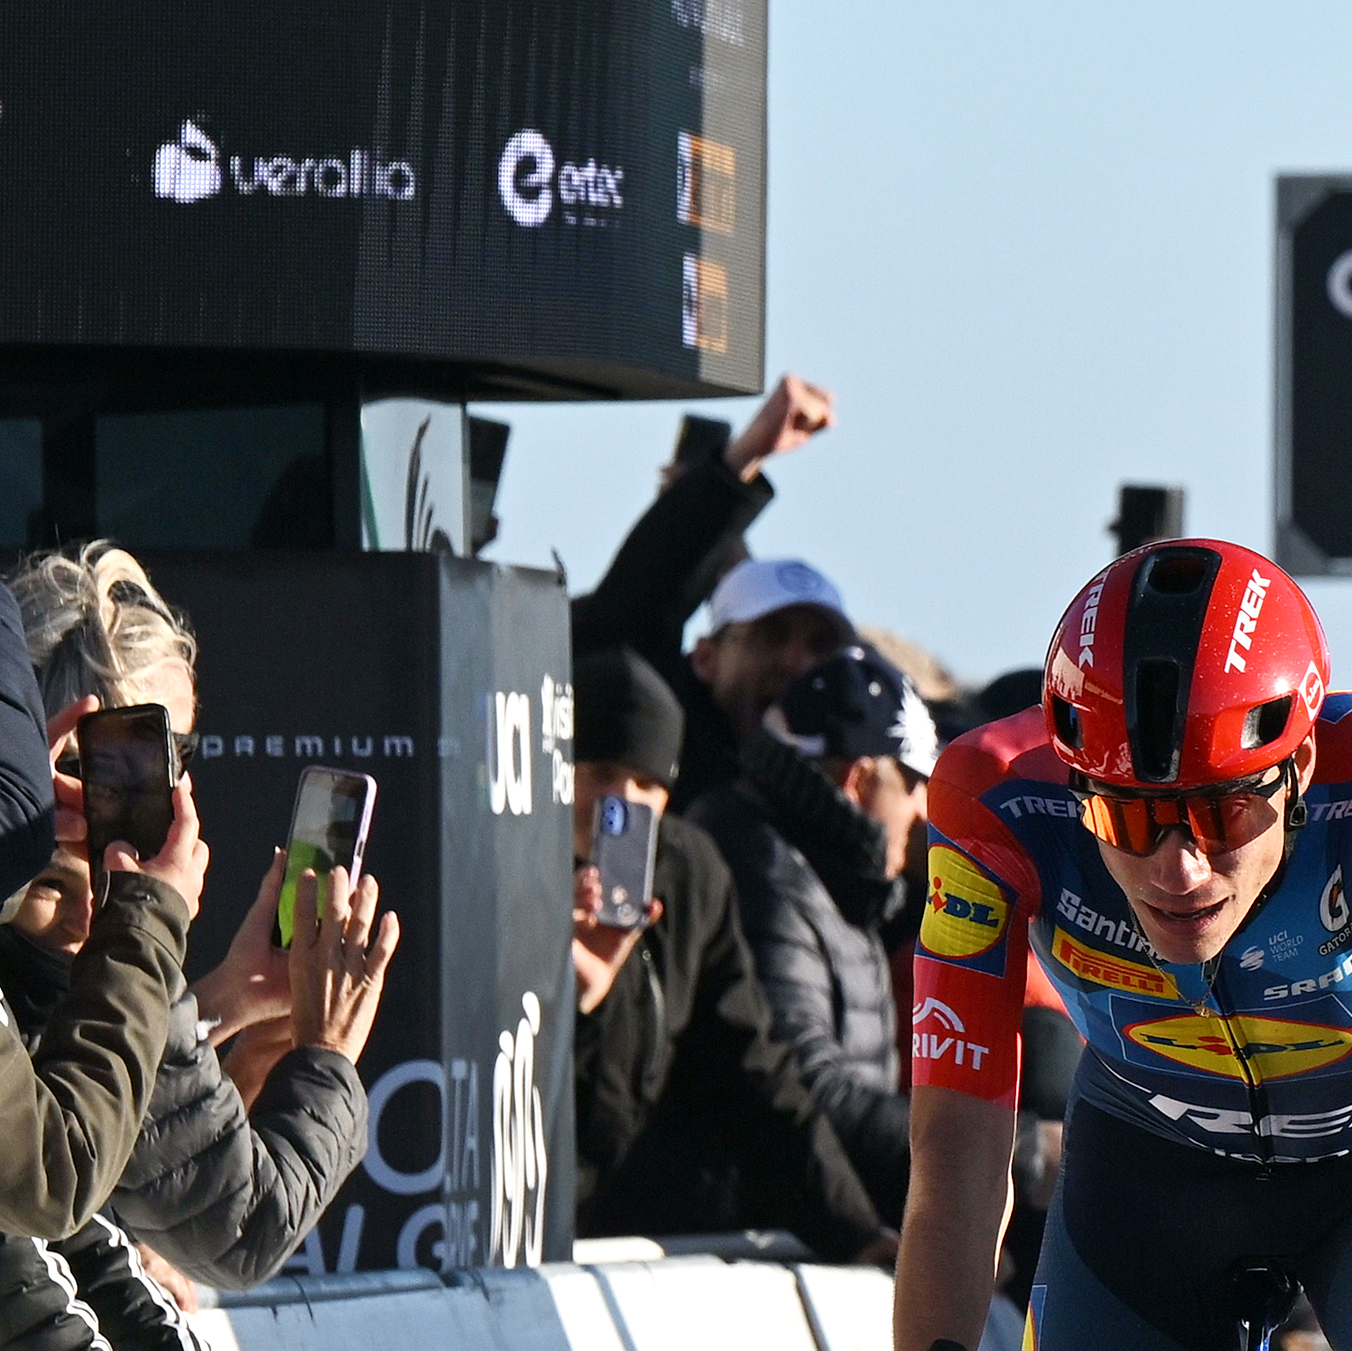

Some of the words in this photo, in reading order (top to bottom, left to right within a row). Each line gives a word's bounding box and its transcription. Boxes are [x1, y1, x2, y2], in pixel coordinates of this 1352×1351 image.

[1224, 568, 1271, 674] TREK
[201, 734, 414, 760] PREMIUM
[1056, 888, 1163, 960] Santin
[1268, 930, 1288, 946] UCI
[1270, 934, 1304, 955] WORLD
[1060, 937, 1167, 994] PIRELLI
[1272, 948, 1299, 963] TEAM
